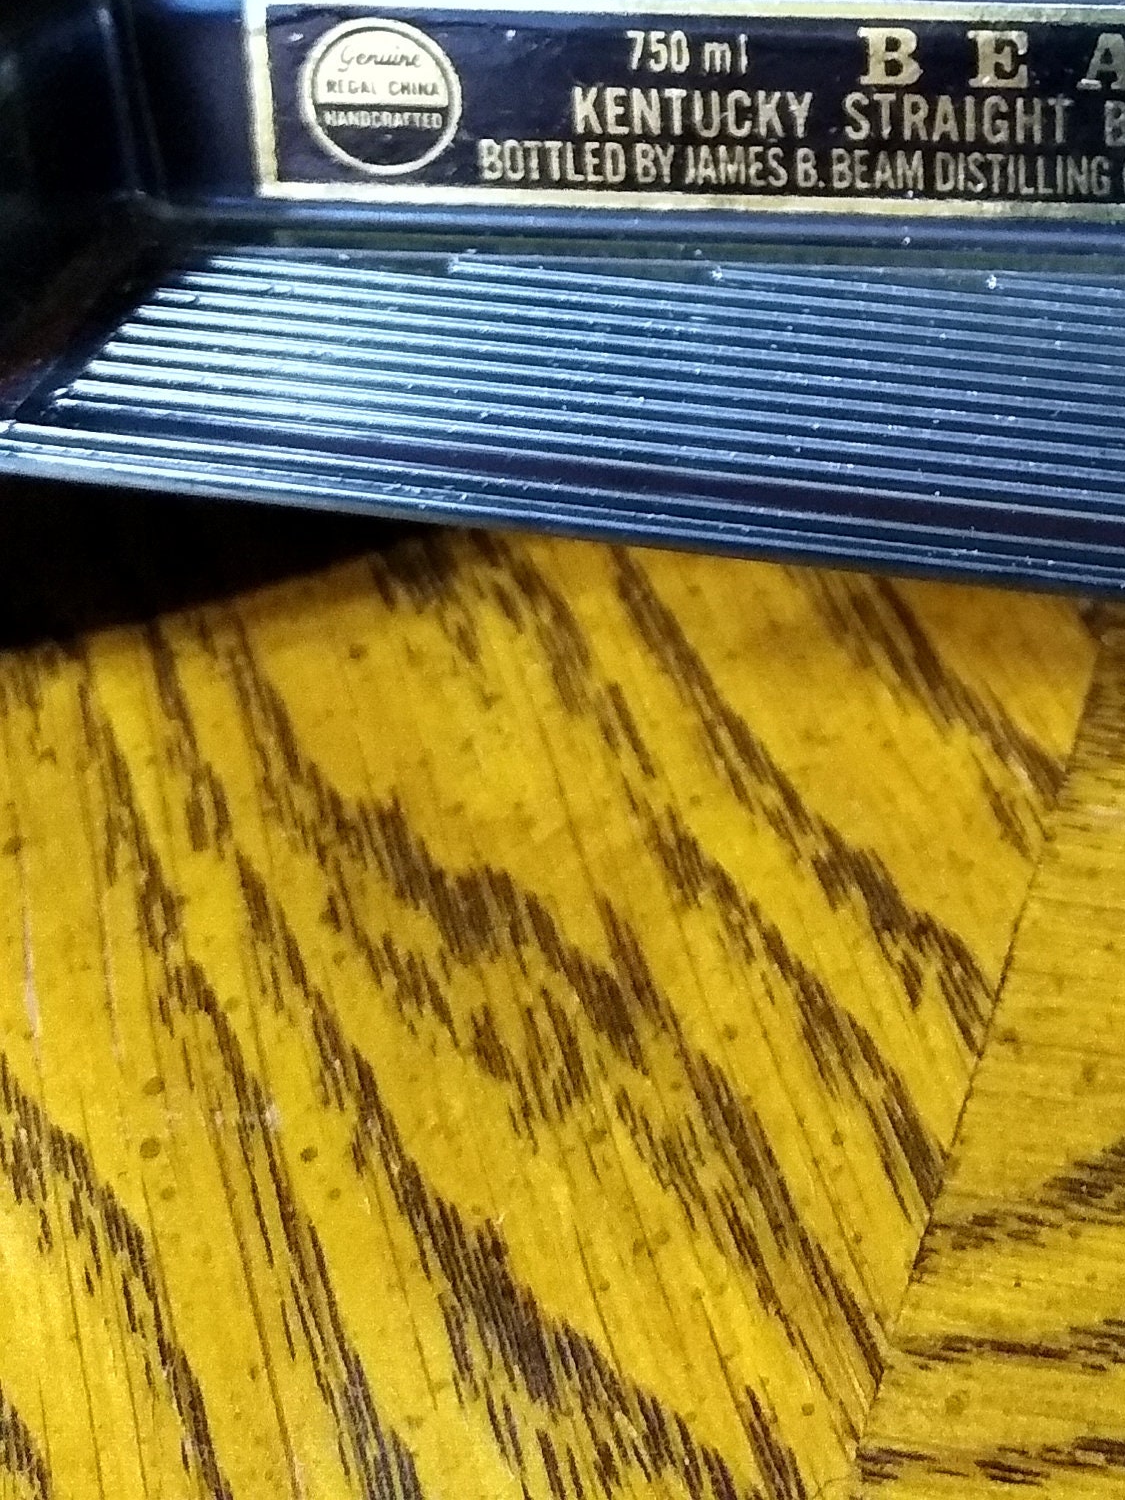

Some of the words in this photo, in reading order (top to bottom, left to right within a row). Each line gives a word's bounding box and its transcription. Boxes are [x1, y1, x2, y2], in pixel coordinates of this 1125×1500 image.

[338, 45, 422, 73] Genuine
[626, 29, 690, 73] 750
[700, 33, 748, 73] ml
[326, 78, 376, 96] REGAL
[388, 80, 440, 97] CHINA
[324, 110, 442, 129] HANDCRAFTED
[573, 84, 813, 138] KENTUCKY
[844, 92, 1074, 146] STRAIGHT
[478, 138, 626, 183] BOTTLED
[635, 142, 675, 184] BY
[685, 144, 789, 187] JAMES
[831, 148, 924, 190] BEAM
[935, 151, 1112, 195] DISTILLING
